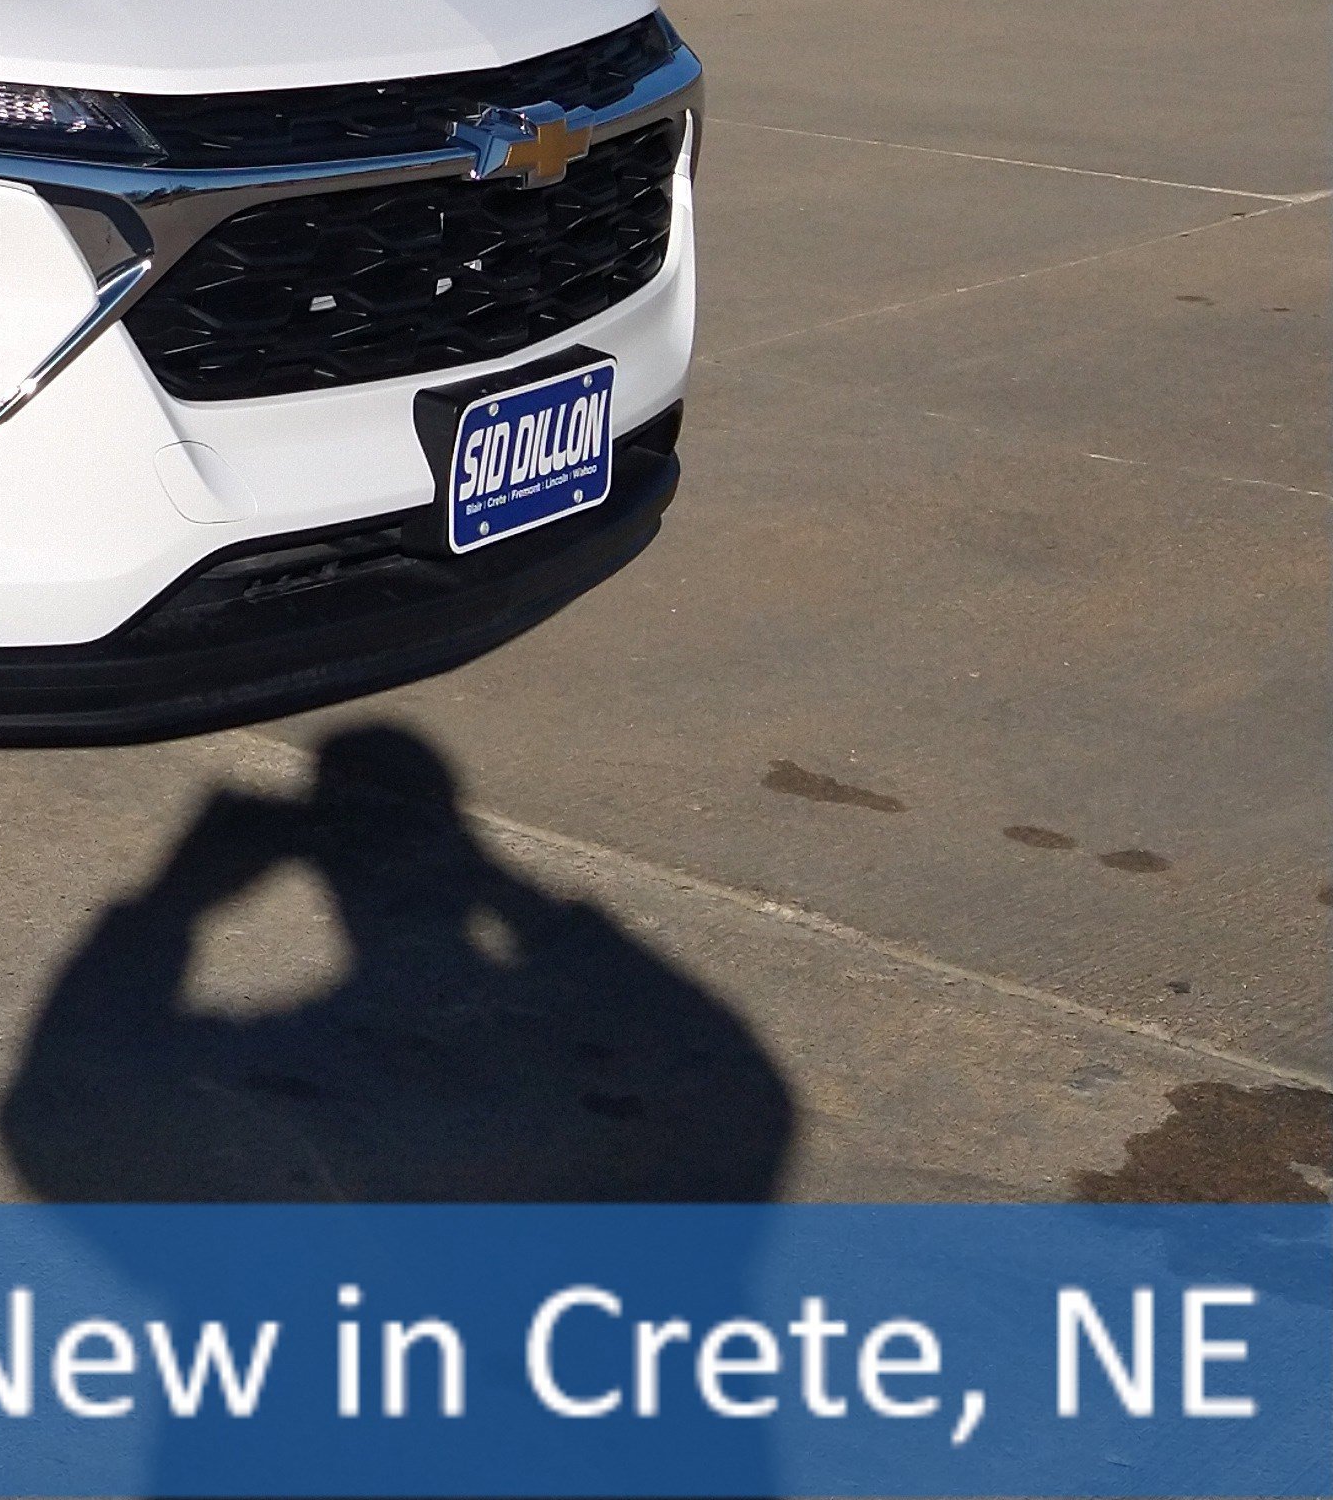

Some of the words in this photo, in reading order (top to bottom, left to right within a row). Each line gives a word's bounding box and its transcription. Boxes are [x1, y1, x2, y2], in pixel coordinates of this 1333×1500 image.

[459, 421, 510, 502] SID
[510, 389, 608, 485] DILLON
[487, 493, 507, 508] Crete
[511, 482, 541, 499] Fremont
[545, 473, 569, 490] Lincoln
